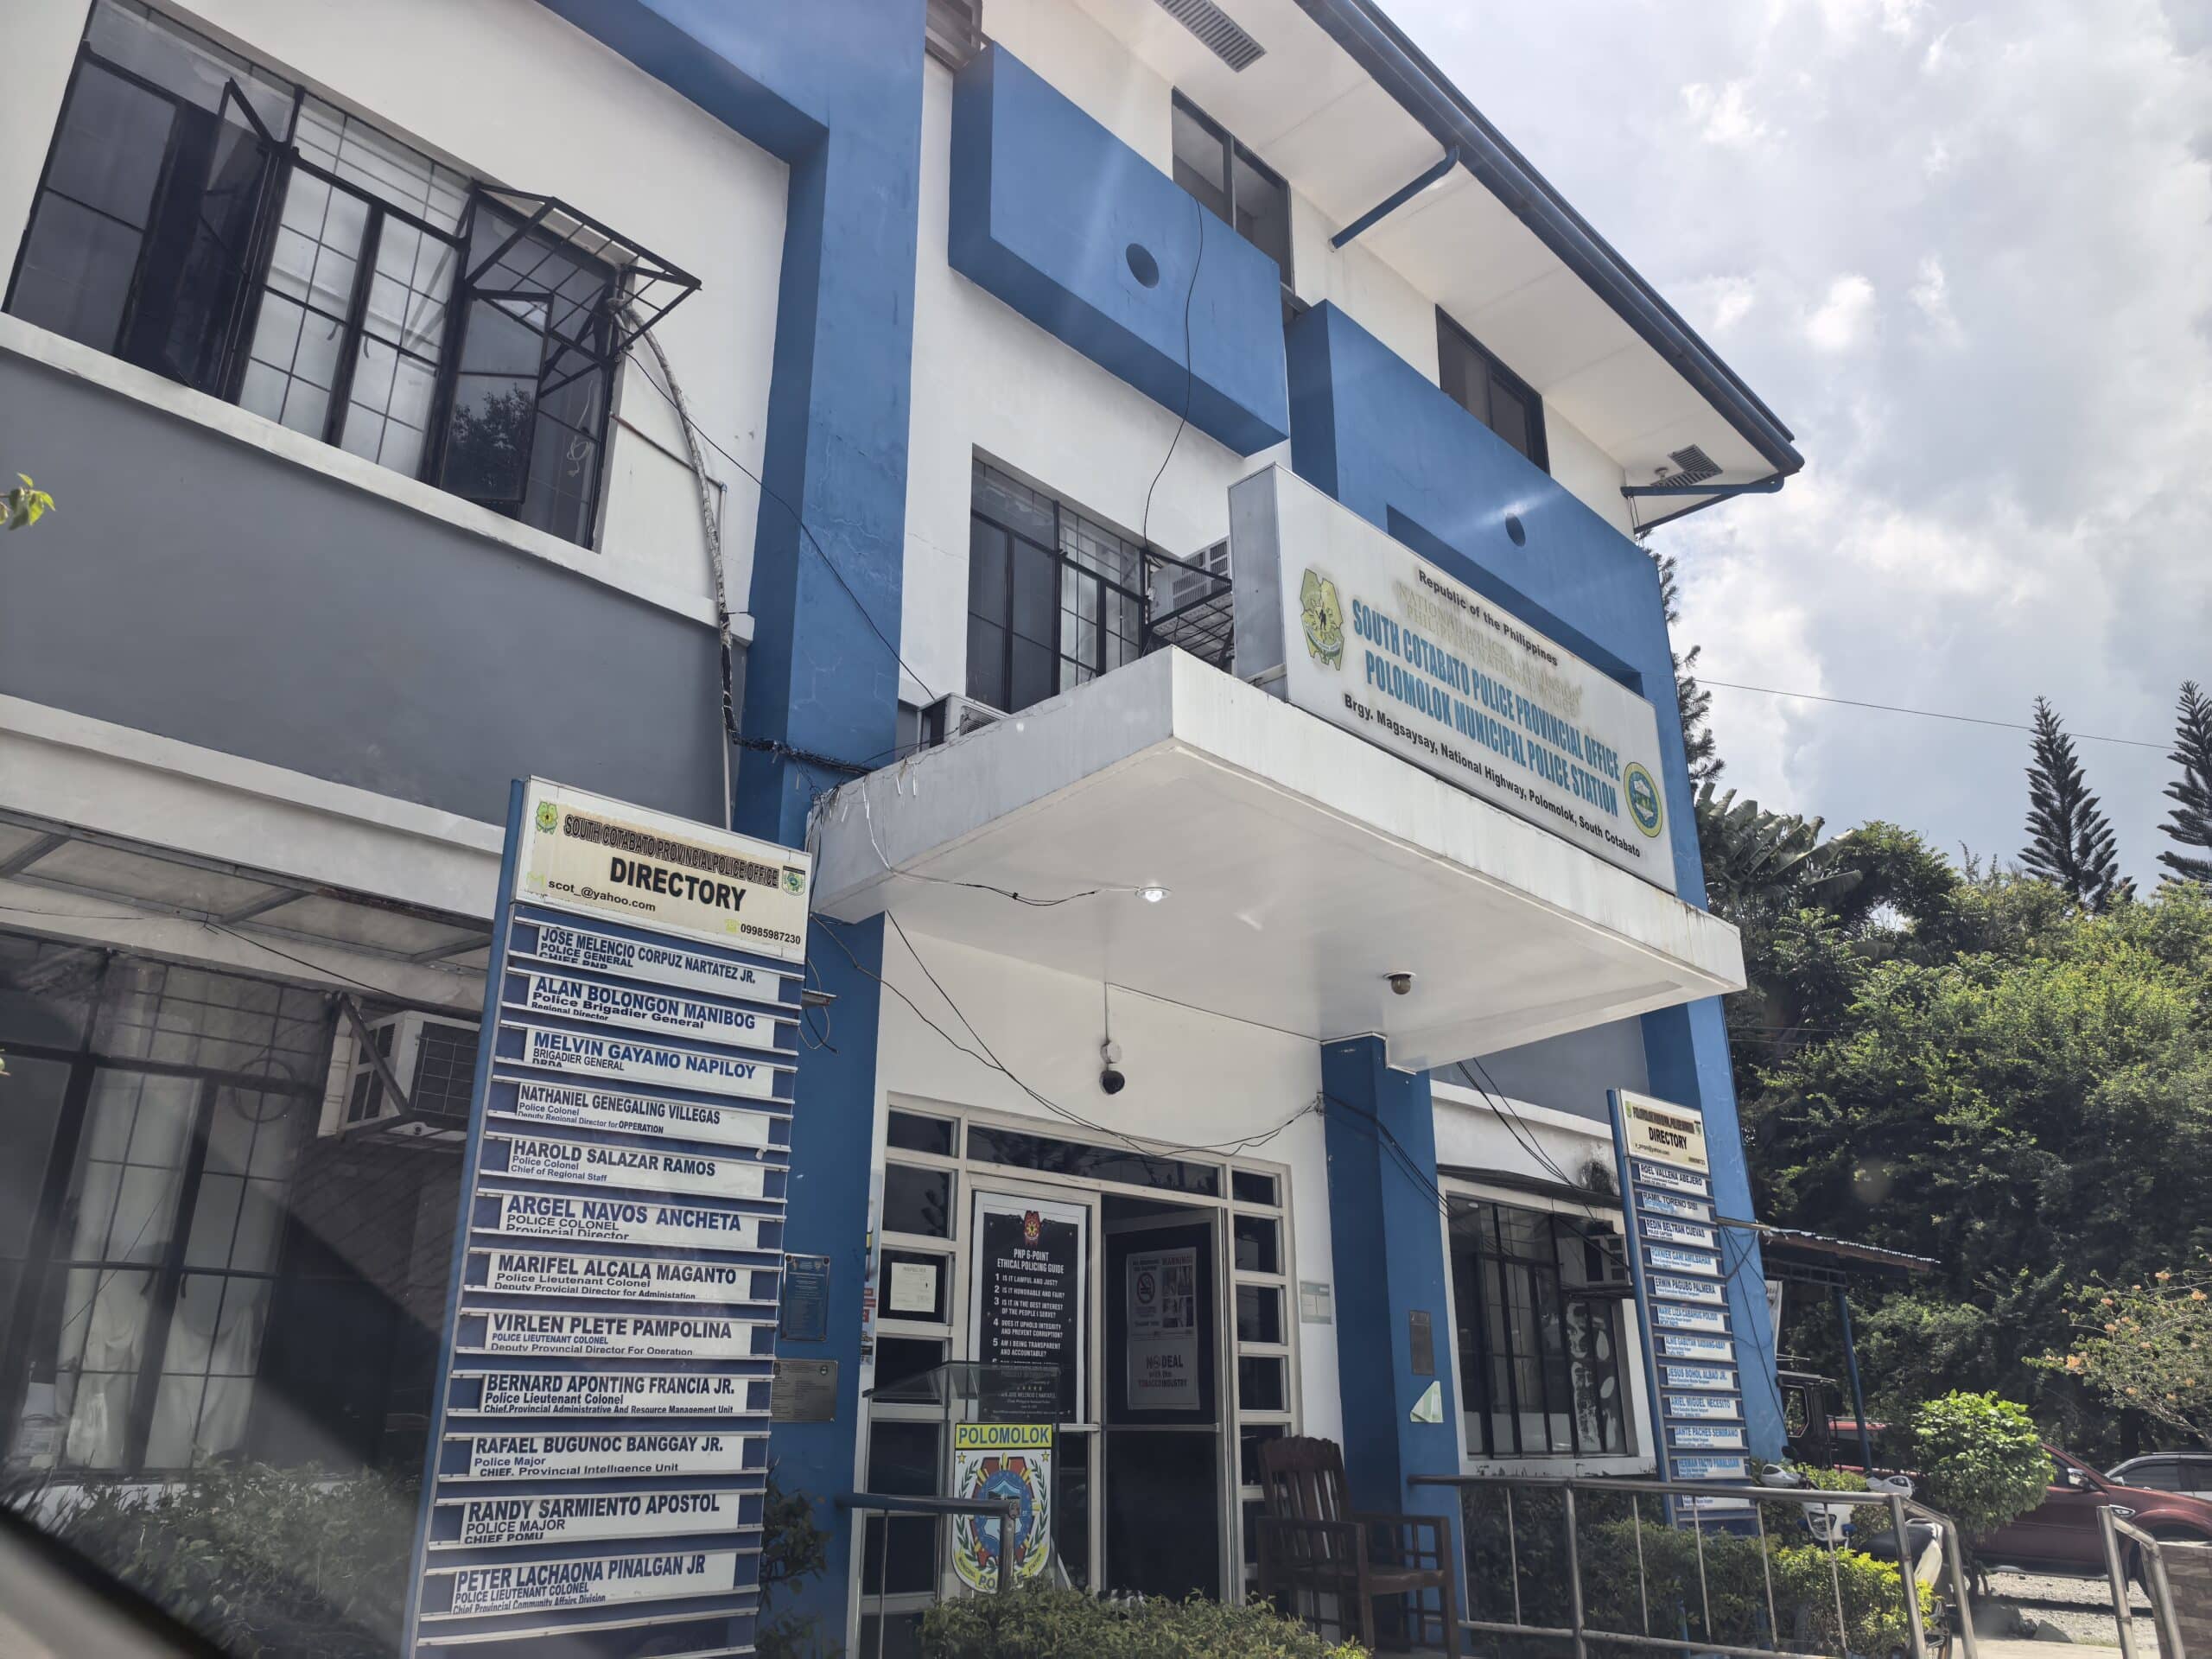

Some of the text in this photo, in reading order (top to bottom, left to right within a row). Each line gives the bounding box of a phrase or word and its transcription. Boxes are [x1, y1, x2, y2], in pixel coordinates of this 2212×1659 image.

[1419, 569, 1558, 666] Republic of the Philippines
[1352, 599, 1401, 657] SOUTH
[1403, 629, 1470, 696] COTABATO
[1471, 668, 1515, 721] POLICE
[1516, 694, 1583, 761] PROVINCIAL
[1585, 734, 1620, 781] OFFICE
[1365, 650, 1618, 817] POLOMOLOK MUNICIPAL POLICE STATION
[1344, 693, 1640, 857] Brgy. Magsaysay, National Highway, Polomolok, South Cotabato
[564, 814, 779, 888] SOUTH COTABATO PROVINCIAL POLICE OFFICE
[610, 857, 746, 911] DIRECTORY
[548, 879, 656, 912] scot_@yahoo.com
[741, 923, 800, 944] 09985987230
[541, 943, 581, 959] POLICE
[584, 951, 632, 968] GENERAL
[542, 927, 755, 983] JOSE MELENCIO CORPUZ NARTATEZ JR.
[533, 992, 703, 1029] Police Brigadier General
[536, 976, 755, 1029] ALAN BOLONGON MANIBOG
[533, 1048, 581, 1065] BRIGADIER
[584, 1056, 624, 1071] GENERAL
[534, 1033, 755, 1079] MELVIN GAYAMO NAPILOY
[519, 1103, 579, 1116] Police Colonel
[521, 1085, 588, 1109] NATHANIEL
[593, 1096, 664, 1117] GENEGALING
[669, 1106, 720, 1124] VILLEGAS
[619, 1121, 663, 1134] OPPERATION
[1649, 1127, 1687, 1149] DIRECTORY
[513, 1155, 579, 1169] Police Colonel
[514, 1141, 715, 1176] HAROLD SALAZAR RAMOS
[511, 1165, 533, 1174] Chief
[548, 1169, 585, 1180] Regional
[507, 1196, 741, 1230] ARGEL NAVOS ANCHETA
[507, 1215, 619, 1230] POLICE COLONEL
[1014, 1248, 1049, 1262] PNP 6-POINT
[499, 1255, 735, 1283] MARIFEL ALCALA MAGANTO
[997, 1258, 1065, 1274] ETHICAL POLICING GUIDE
[498, 1274, 650, 1287] Police Lieutenant Colonel
[995, 1285, 1000, 1294] 2
[582, 1287, 620, 1295] Director
[994, 1297, 999, 1306] 3
[494, 1314, 731, 1338] VIRLEN PLETE PAMPOLINA
[993, 1318, 998, 1326] 4
[523, 1334, 571, 1344] LIEUTENANT
[574, 1336, 608, 1344] COLONEL
[531, 1344, 582, 1353] Provincial
[586, 1345, 625, 1354] Director
[993, 1338, 998, 1346] 5
[487, 1375, 734, 1394] BERNARD APONTING FRANCIA JR.
[486, 1393, 623, 1404] Police Lieutenant Colonel
[476, 1437, 722, 1453] RAFAEL BUGUNOC BANGGAY JR.
[959, 1427, 1049, 1444] POLOMOLOK
[475, 1458, 545, 1466] Police Major
[519, 1466, 580, 1475] Provincial
[656, 1463, 677, 1471] Unit
[468, 1494, 720, 1522] RANDY SARMIENTO APOSTOL
[467, 1519, 565, 1535] POLICE MAJOR
[465, 1535, 504, 1544] CHIEF
[457, 1554, 705, 1592] PETER LACHAONA PINALGAN JR
[455, 1583, 588, 1604] POLICE LIEUTENANT COLONEL
